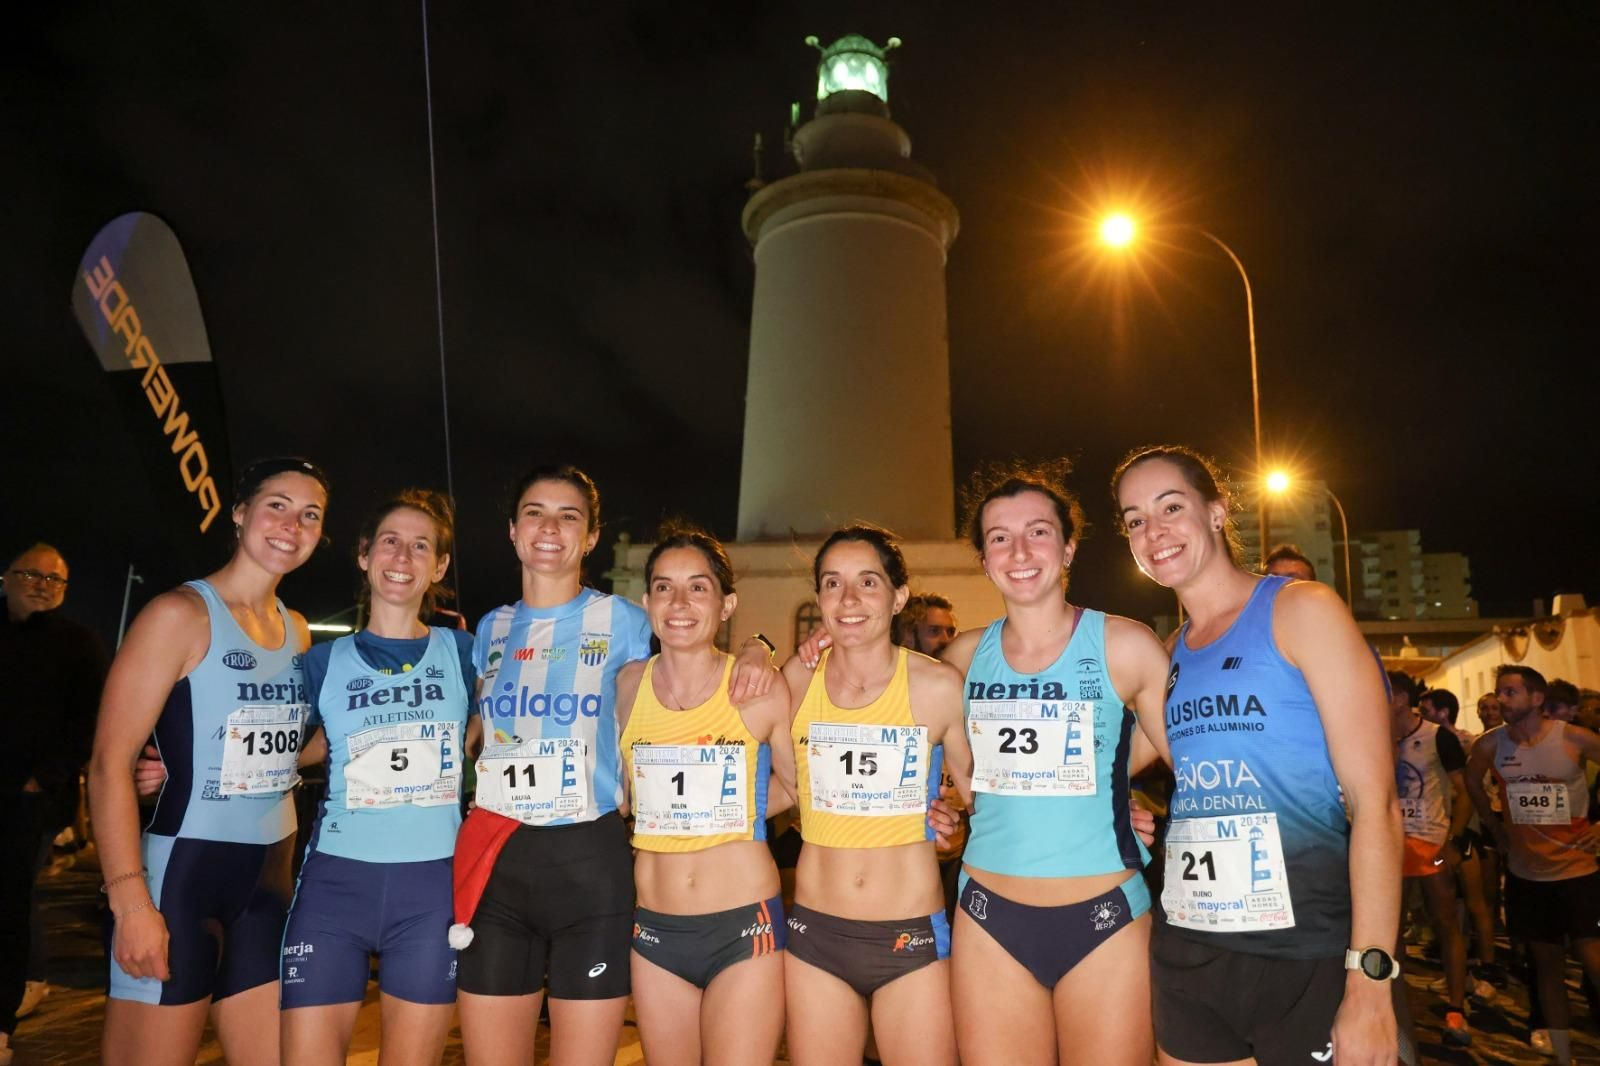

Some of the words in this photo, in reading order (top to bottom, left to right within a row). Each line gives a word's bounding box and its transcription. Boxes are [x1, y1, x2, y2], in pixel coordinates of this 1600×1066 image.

[223, 653, 257, 669] TROPS
[237, 678, 308, 704] nerja
[346, 678, 445, 711] nerja
[363, 709, 434, 727] ATLETISMO
[1166, 694, 1267, 729] LUSIGMA
[243, 729, 298, 755] 1308
[998, 727, 1039, 754] 23
[1169, 725, 1194, 744] ACIONES
[1196, 724, 1206, 734] DE
[1208, 722, 1264, 733] ALUMINIO
[390, 748, 409, 771] 5
[839, 750, 878, 776] 15
[503, 764, 536, 788] 11
[671, 771, 684, 796] 1
[1011, 769, 1056, 780] mayoral
[394, 784, 432, 794] mayoral
[852, 790, 891, 801] mayoral
[515, 800, 553, 812] mayoral
[1173, 796, 1198, 814] NICA
[1203, 795, 1267, 809] DENTAL
[1519, 796, 1549, 808] 848
[673, 810, 713, 821] mayoral
[1181, 850, 1216, 881] 21
[1197, 899, 1244, 912] mayoral
[741, 922, 772, 937] vive
[284, 941, 314, 956] nerja
